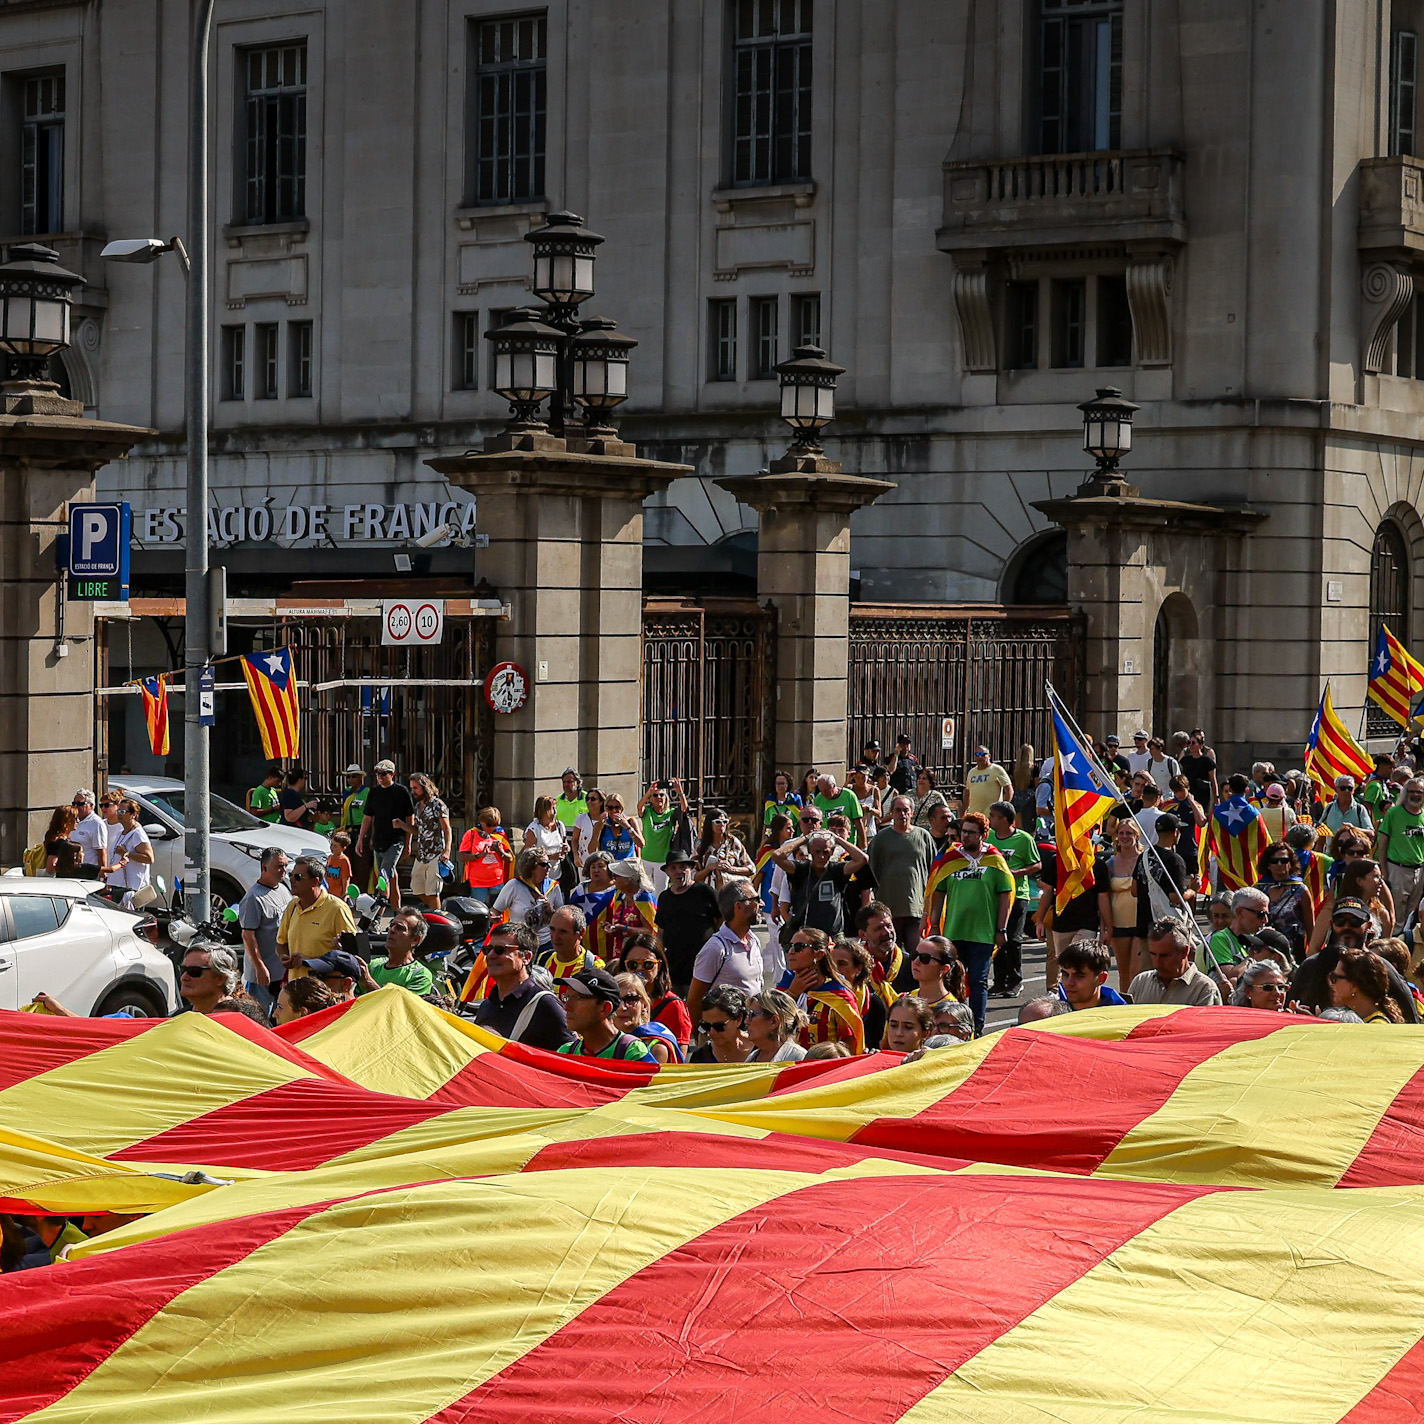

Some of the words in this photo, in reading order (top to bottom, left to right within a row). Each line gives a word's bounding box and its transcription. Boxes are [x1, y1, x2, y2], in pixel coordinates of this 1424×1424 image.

[144, 496, 273, 541] ESACIÓ
[286, 504, 330, 540] DE
[82, 513, 108, 560] P
[77, 582, 108, 597] LIBRE
[391, 616, 408, 629] 2,60
[421, 616, 433, 628] 10
[970, 774, 990, 783] CAT
